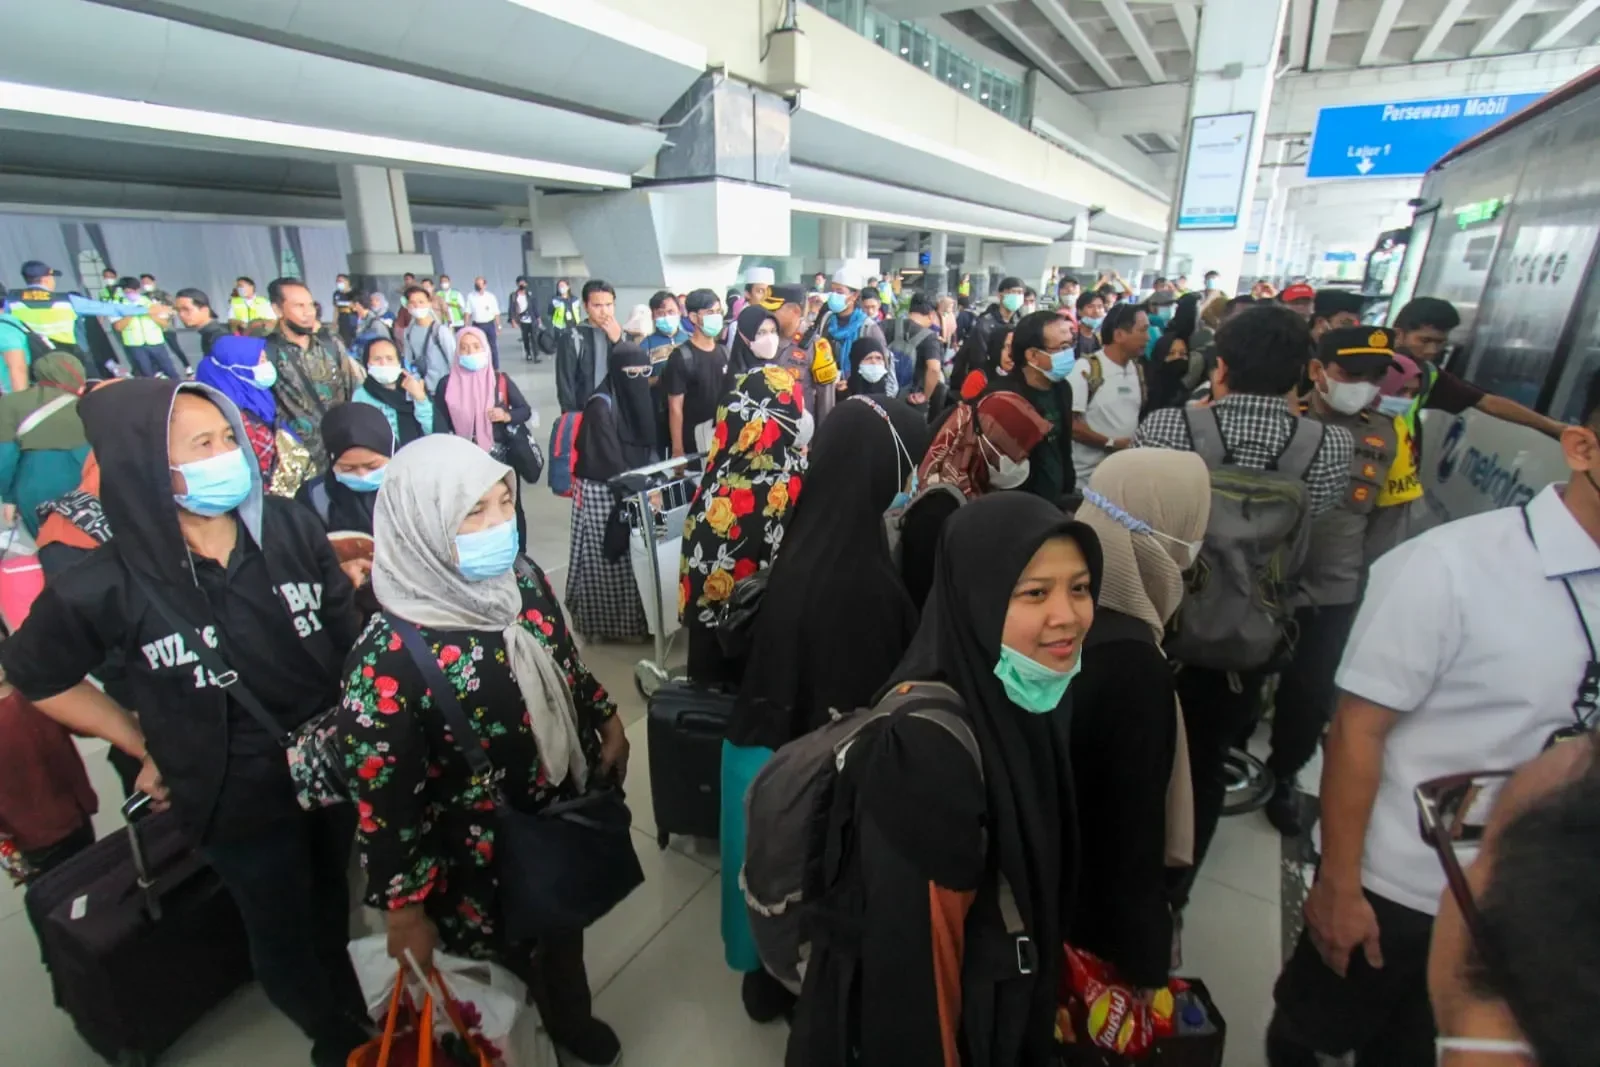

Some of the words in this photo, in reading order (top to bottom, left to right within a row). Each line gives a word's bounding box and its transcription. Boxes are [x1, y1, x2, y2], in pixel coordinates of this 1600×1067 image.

[1382, 104, 1460, 121] Persewaan
[1464, 97, 1509, 116] Mobil
[1347, 145, 1381, 158] Lajur
[1383, 144, 1391, 155] 1
